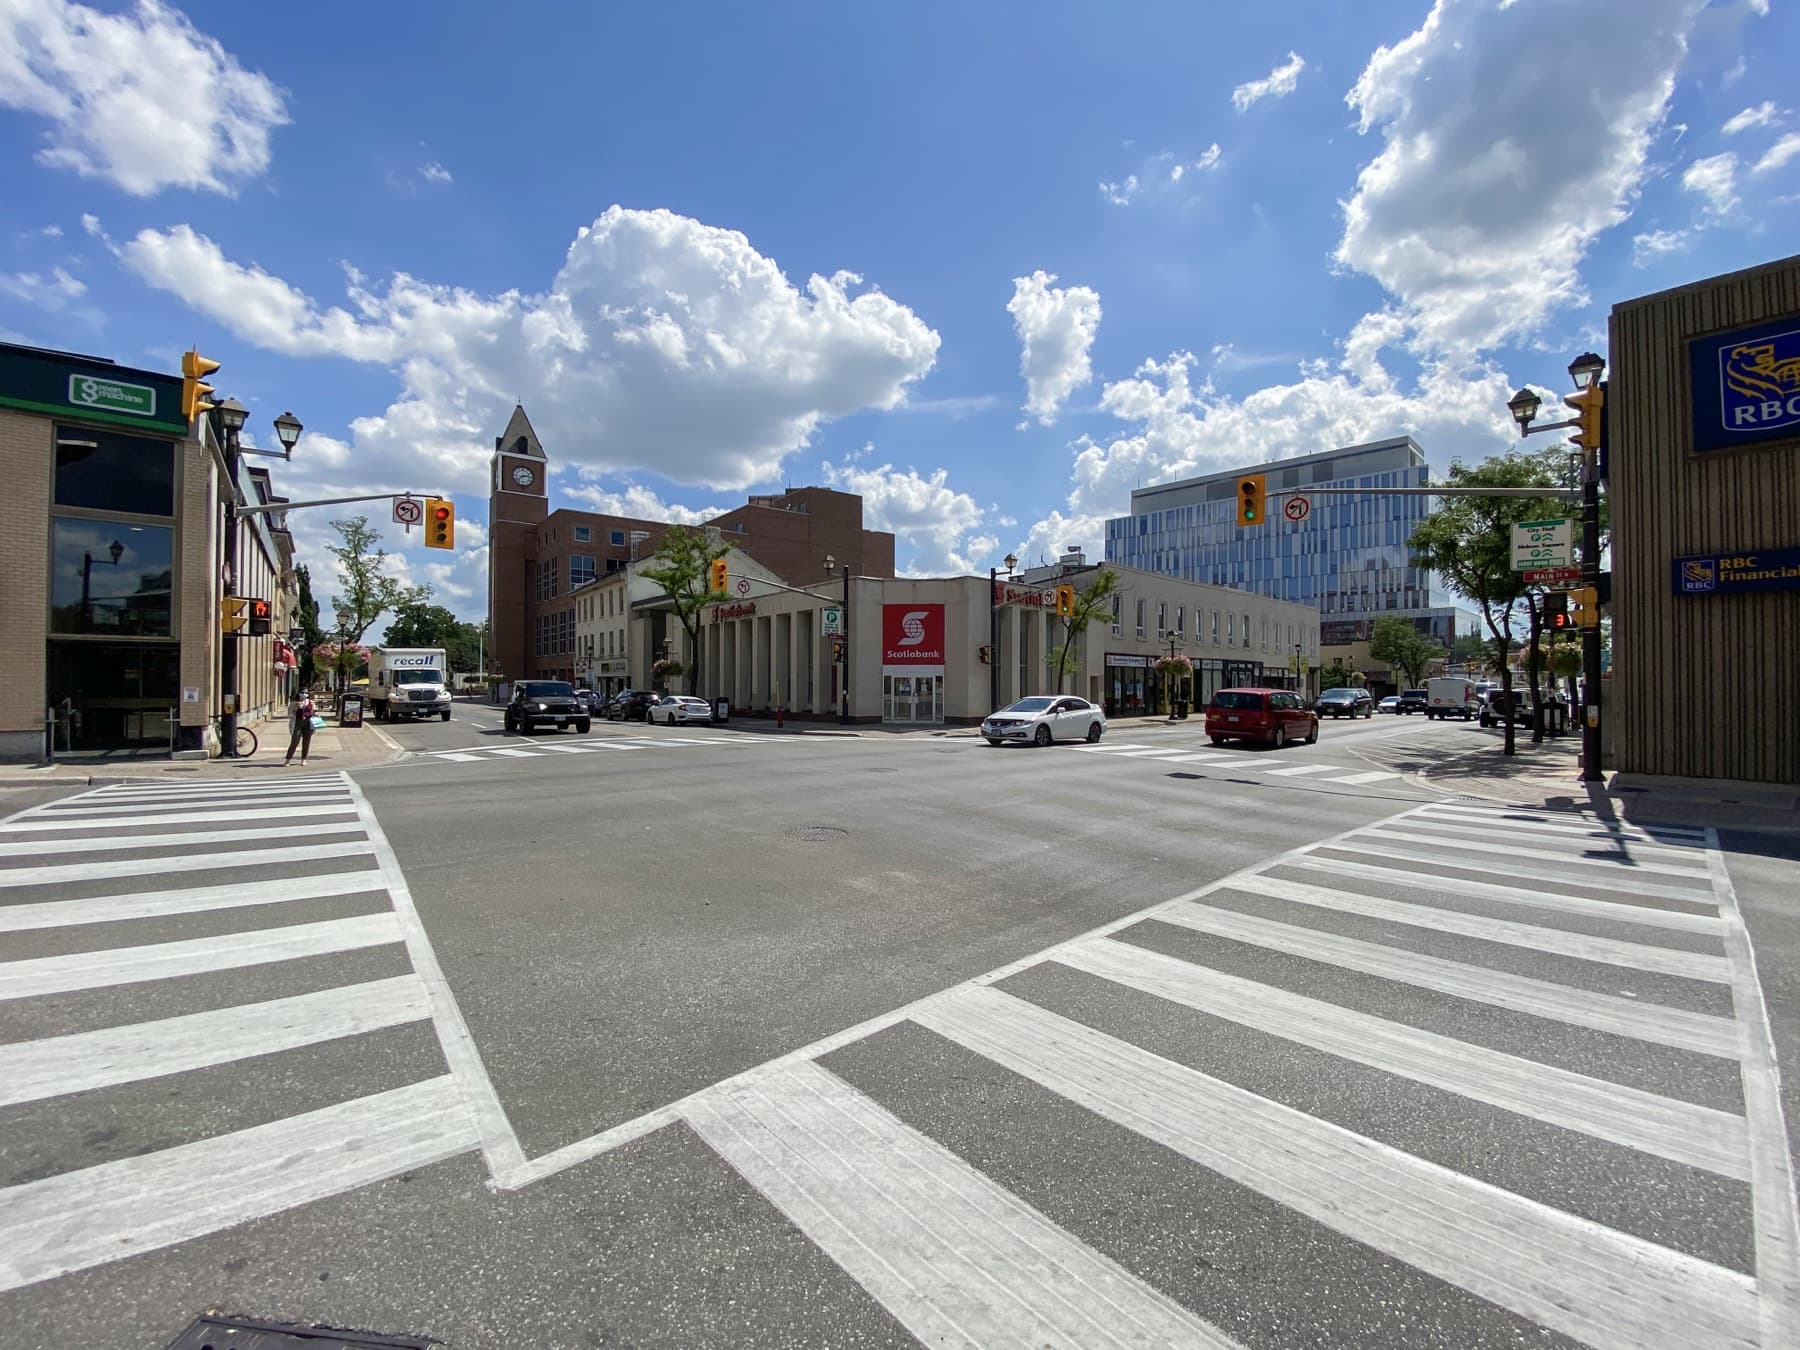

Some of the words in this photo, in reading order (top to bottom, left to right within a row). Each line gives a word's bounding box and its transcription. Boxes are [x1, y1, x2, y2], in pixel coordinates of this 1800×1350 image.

[98, 389, 143, 404] machine
[1734, 395, 1800, 425] RBC
[1720, 556, 1759, 569] RBC
[1533, 572, 1554, 580] MAIN
[1686, 580, 1711, 590] RBC
[1555, 614, 1564, 626] 3
[887, 649, 940, 659] Scotiabank
[394, 655, 434, 666] recall
